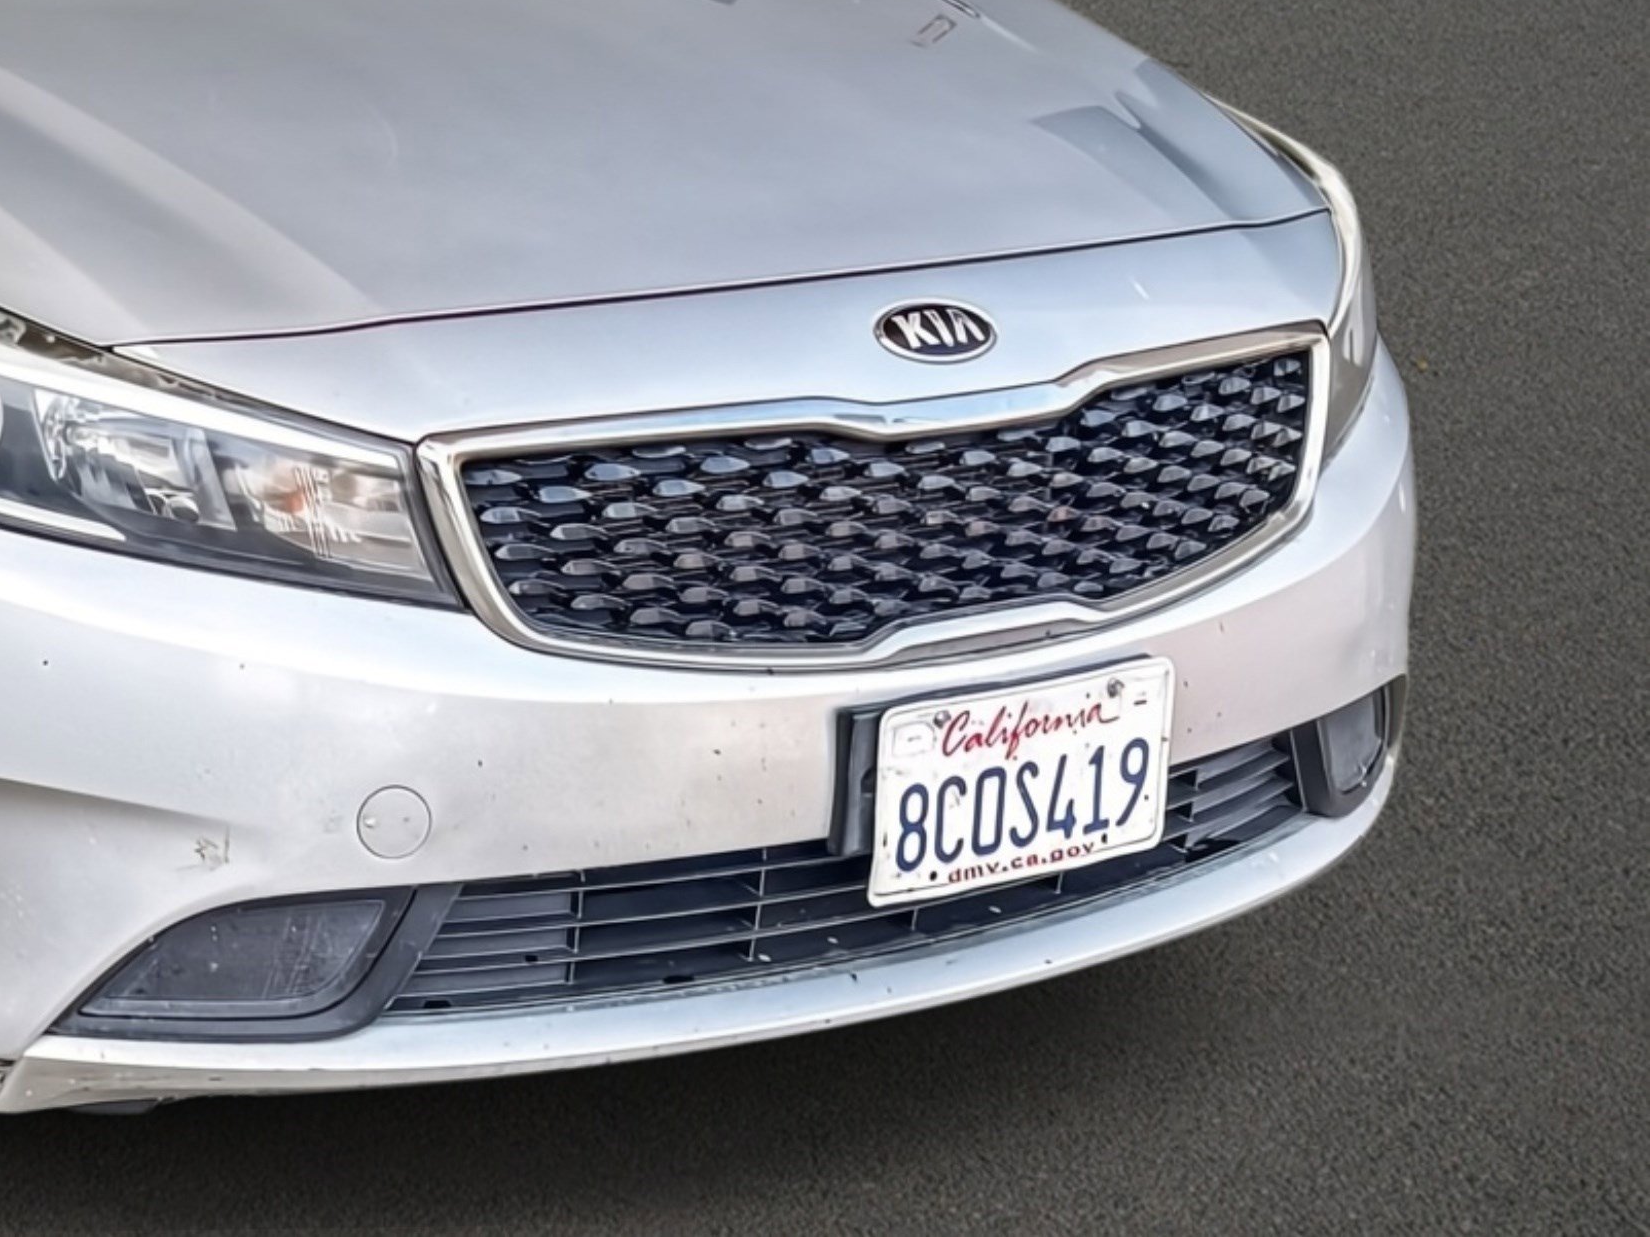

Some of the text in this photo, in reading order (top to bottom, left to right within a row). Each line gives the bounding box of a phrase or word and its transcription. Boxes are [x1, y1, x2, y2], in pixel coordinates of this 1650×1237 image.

[890, 308, 985, 349] KIA
[940, 699, 1120, 760] California
[895, 736, 1150, 873] 8COS419
[947, 840, 1096, 885] dmv.ca.gov
